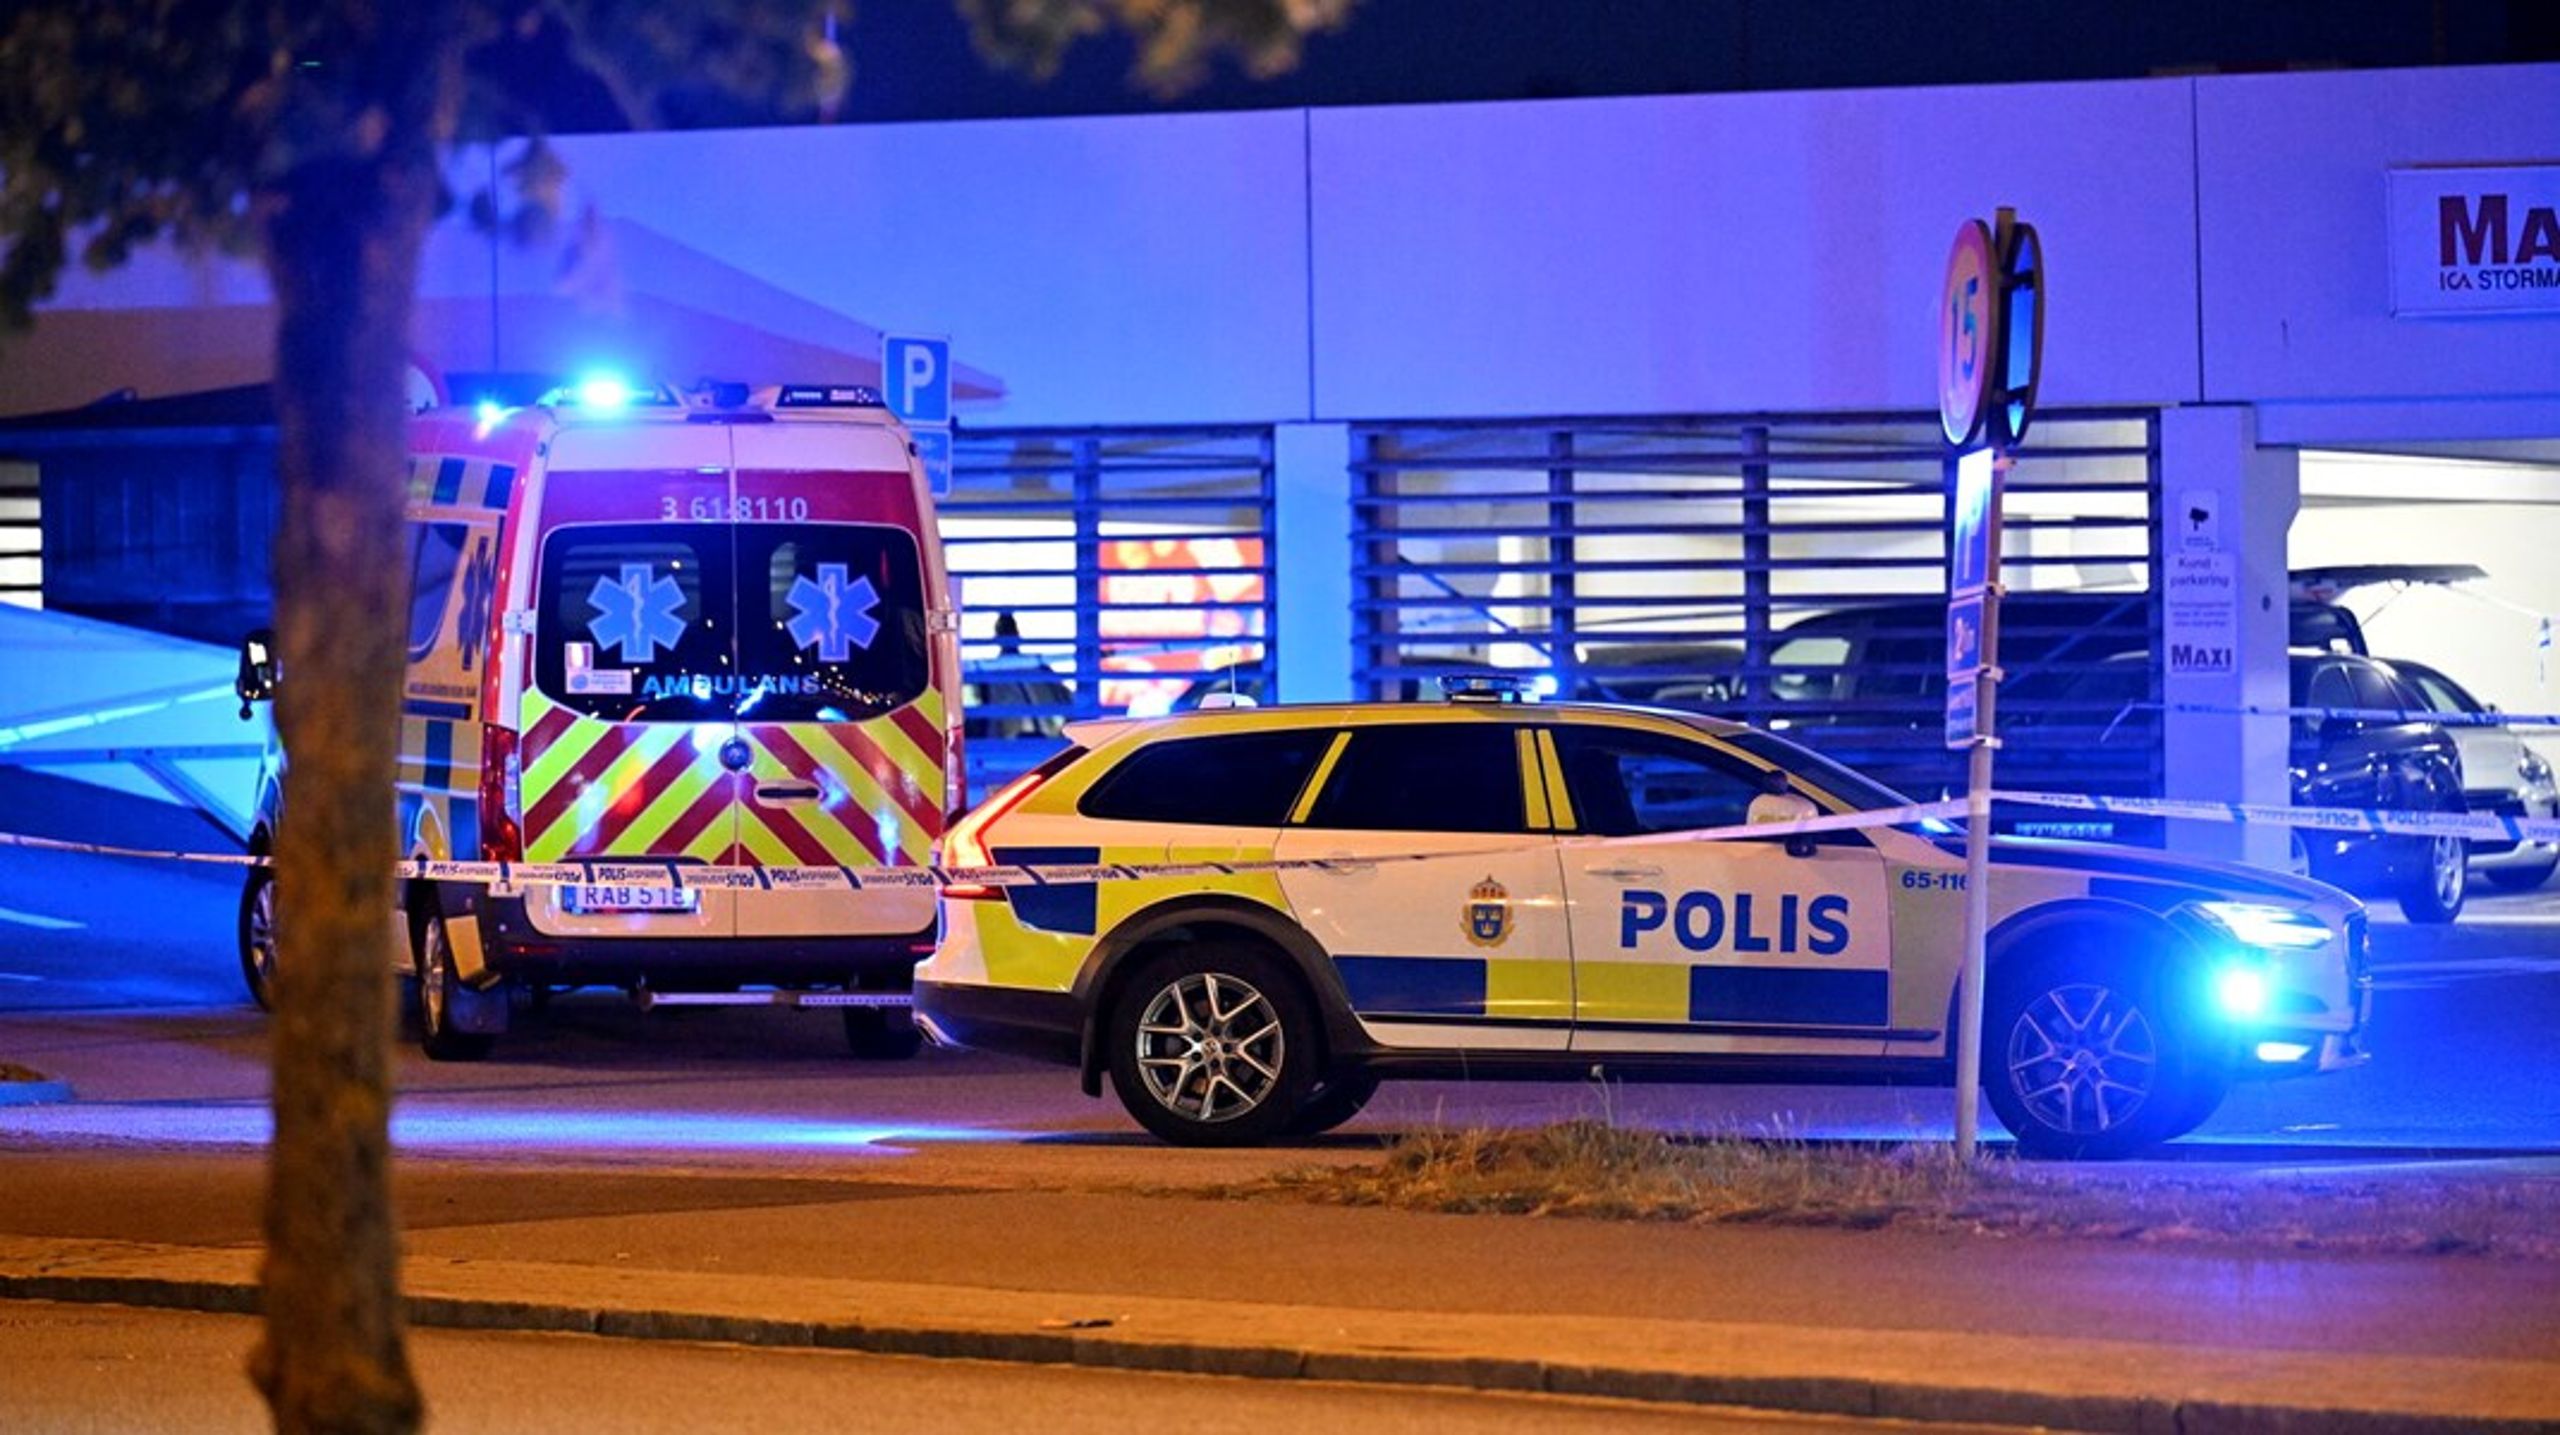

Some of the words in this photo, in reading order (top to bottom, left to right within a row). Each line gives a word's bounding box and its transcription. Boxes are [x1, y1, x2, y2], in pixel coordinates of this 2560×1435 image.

[2440, 271, 2473, 290] ICA
[1951, 277, 1979, 386] 15
[903, 344, 936, 415] P
[661, 496, 678, 521] 3
[2170, 644, 2232, 668] MAXI
[641, 674, 821, 696] AMBULANS
[585, 886, 631, 905] RAB
[1619, 889, 1851, 956] POLIS
